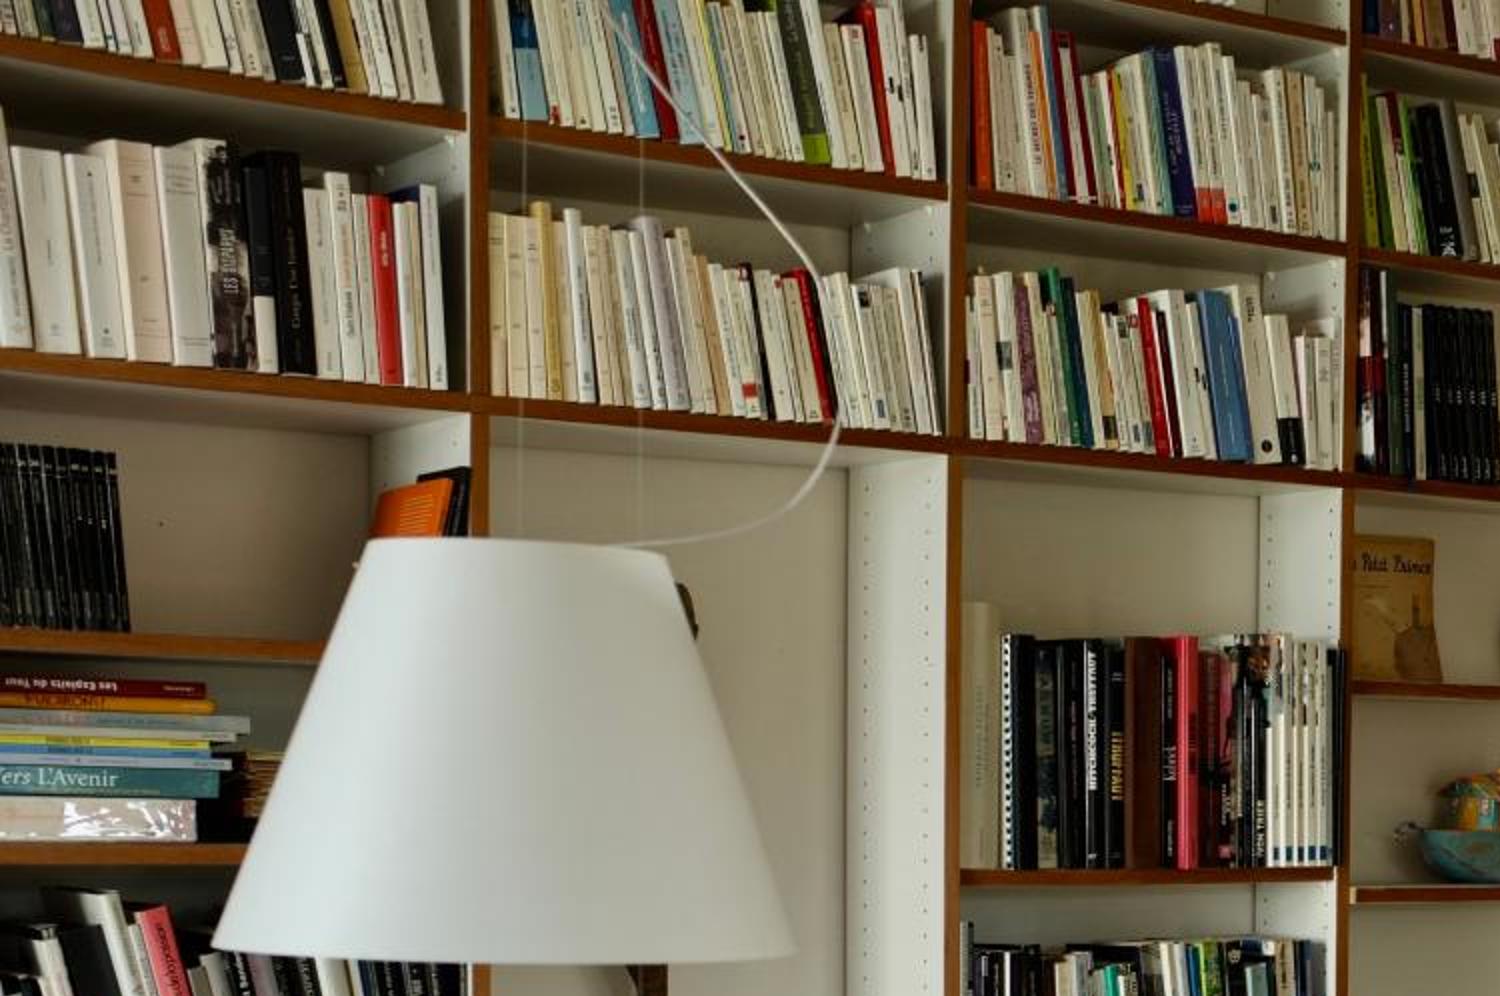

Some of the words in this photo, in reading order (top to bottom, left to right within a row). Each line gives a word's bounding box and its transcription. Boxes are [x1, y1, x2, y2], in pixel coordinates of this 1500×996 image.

[33, 678, 48, 689] du
[51, 678, 96, 691] Exploits
[98, 682, 117, 692] Les
[0, 768, 31, 786] ers
[38, 768, 119, 787] L'Avenir
